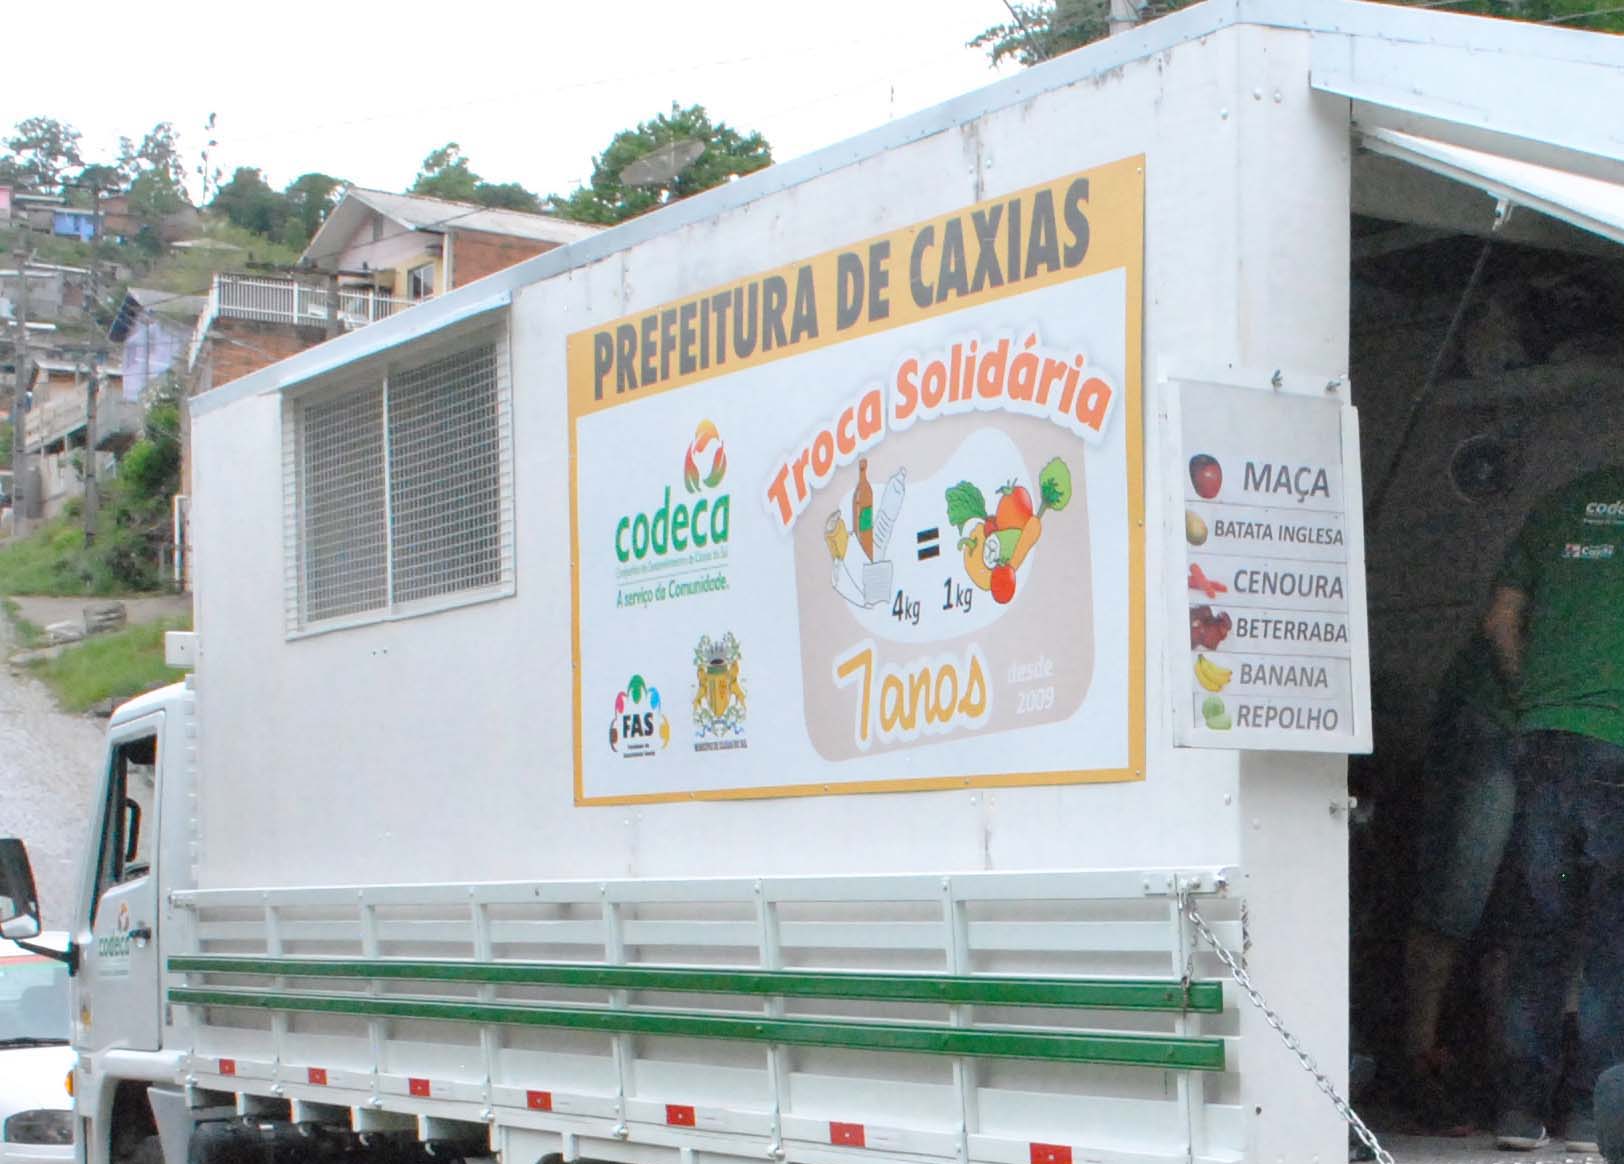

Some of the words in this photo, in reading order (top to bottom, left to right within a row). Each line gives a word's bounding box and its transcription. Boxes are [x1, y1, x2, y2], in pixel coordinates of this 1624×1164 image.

[593, 264, 819, 401] PREFEITURA
[836, 240, 891, 332] DE
[909, 178, 1090, 309] CAXIAS
[766, 389, 882, 526] Troca
[895, 332, 1113, 433] Solidária
[1243, 461, 1331, 503] MAÇA
[615, 484, 731, 563] codeca
[1214, 519, 1273, 541] BATATA
[1278, 525, 1344, 546] INGLESA
[942, 577, 973, 613] 1kg
[1233, 569, 1344, 599] CENOURA
[891, 589, 921, 626] 4kg
[1236, 617, 1348, 643] BETERRABA
[1007, 655, 1054, 684] desde
[1239, 663, 1329, 689] BANANA
[1015, 686, 1055, 715] 2009
[622, 712, 655, 738] FAS
[1236, 704, 1339, 731] REPOLHO
